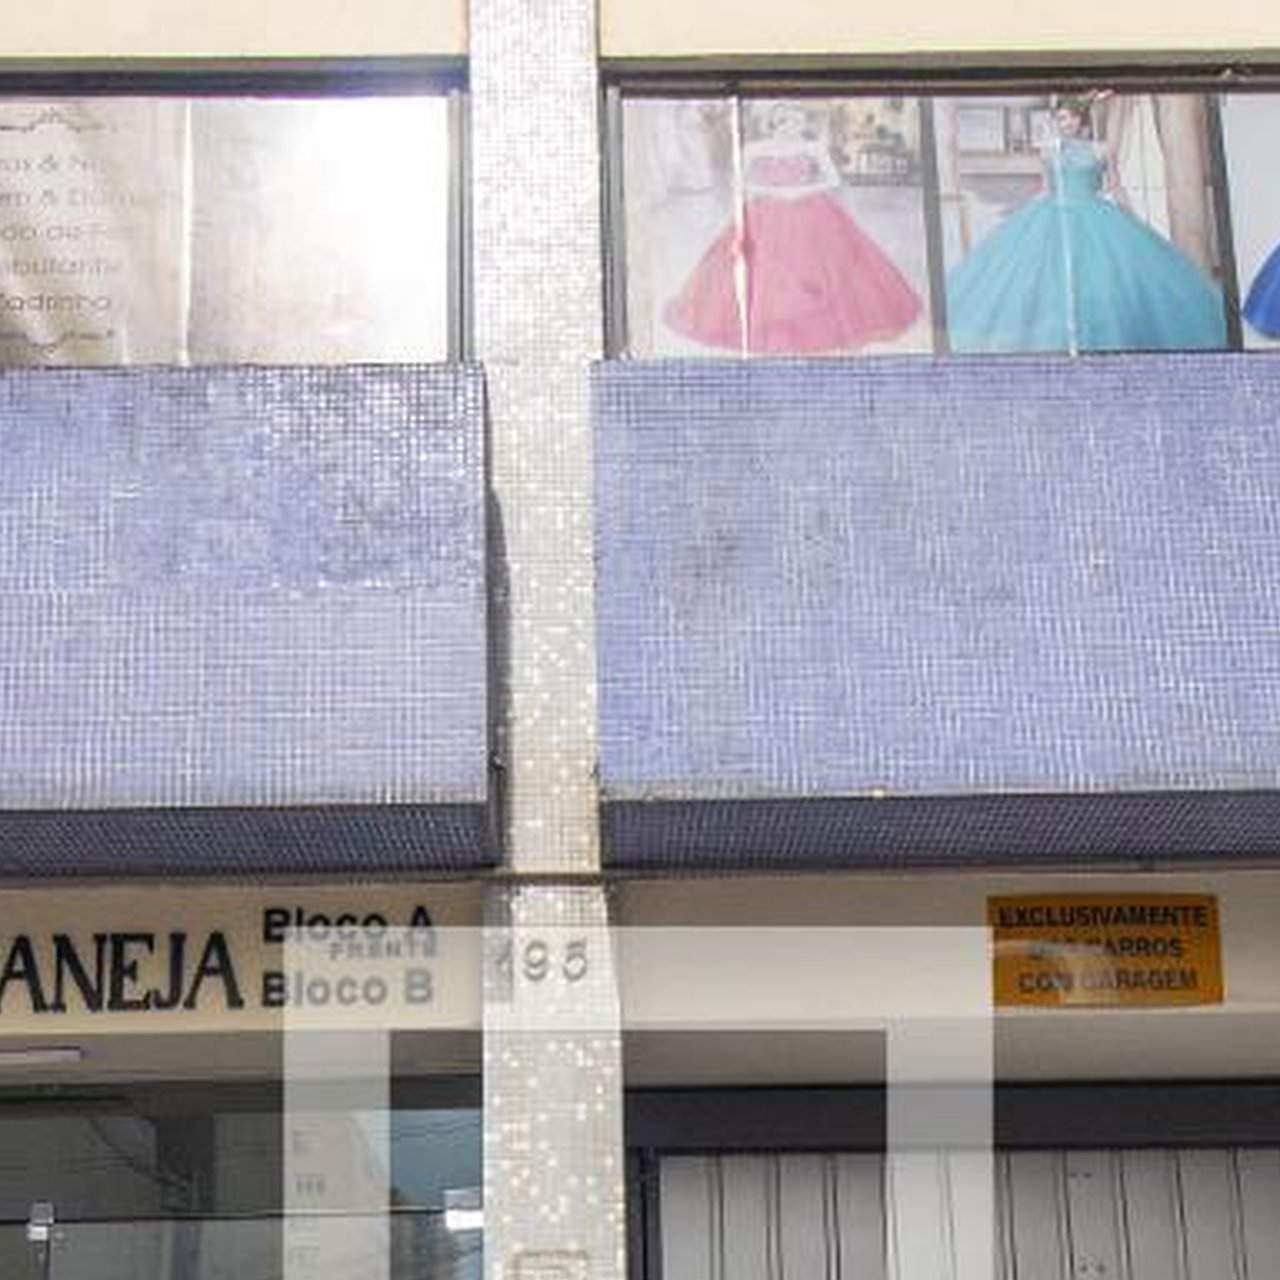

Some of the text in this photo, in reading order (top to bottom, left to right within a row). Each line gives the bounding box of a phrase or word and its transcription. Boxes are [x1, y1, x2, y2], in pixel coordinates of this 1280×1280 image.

[263, 905, 437, 944] Bloco A
[998, 905, 1209, 928] EXCLUSIVAMENTE
[262, 967, 434, 1007] Bloco B
